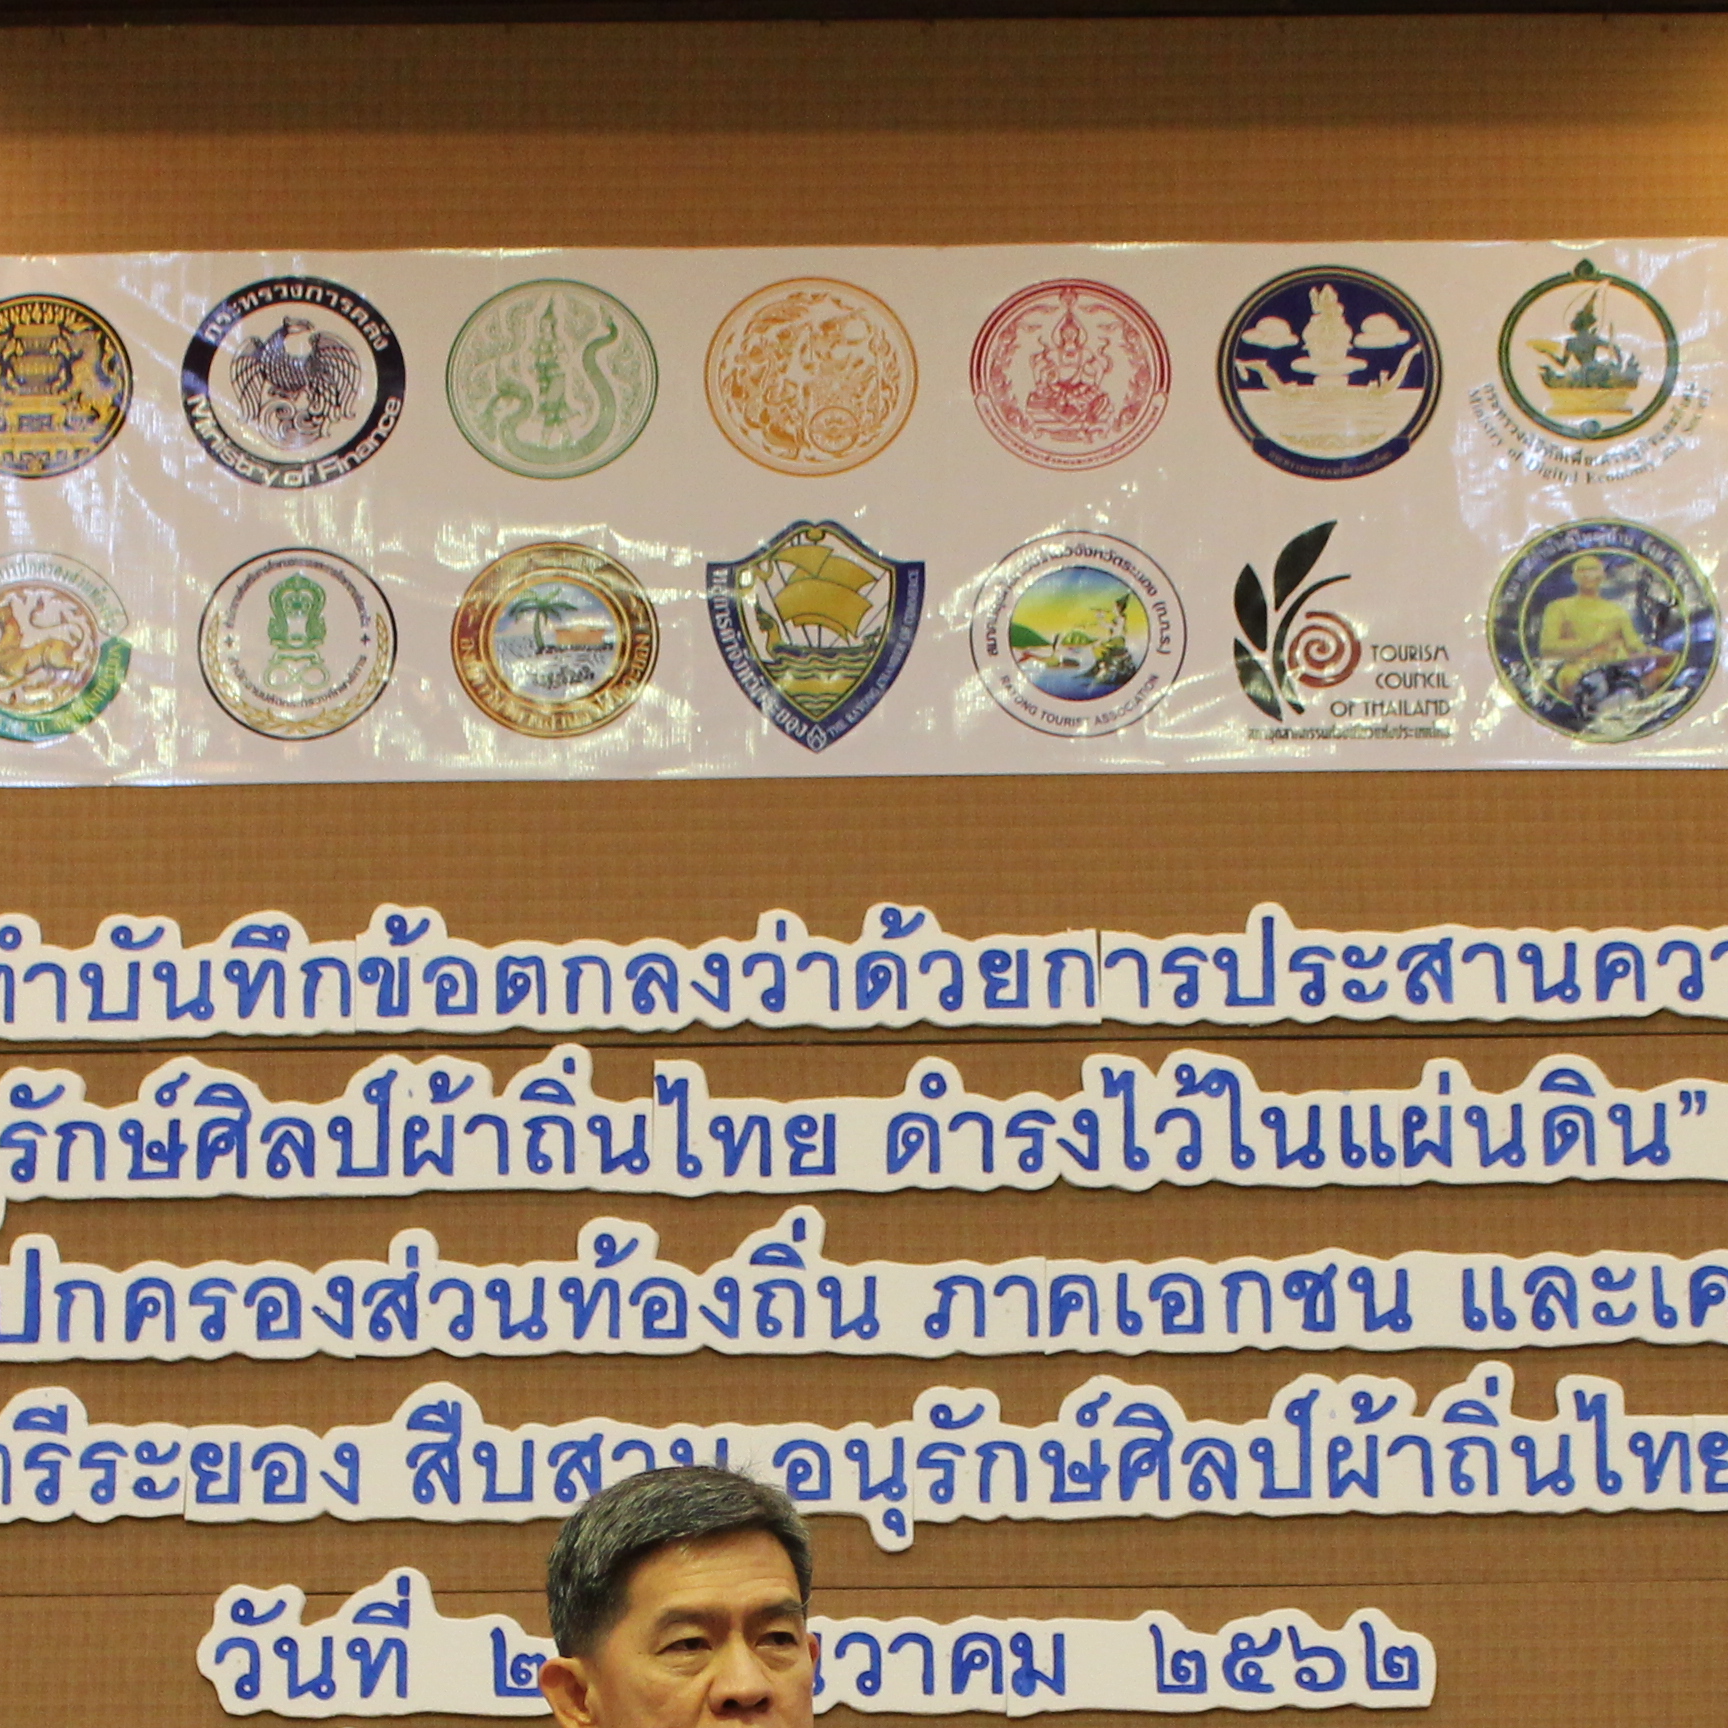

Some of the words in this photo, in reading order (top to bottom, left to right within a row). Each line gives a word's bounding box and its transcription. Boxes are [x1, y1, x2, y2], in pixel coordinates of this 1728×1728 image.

[204, 282, 389, 351] กระทรวงการคลัง
[187, 393, 278, 487] Ministry
[283, 463, 317, 486] of
[316, 396, 402, 481] Finance
[1371, 644, 1450, 662] TOURISM
[1375, 671, 1450, 690] COUNCIL
[1094, 674, 1160, 726] ASSOCIATION
[1330, 701, 1354, 717] OF
[1364, 700, 1451, 717] THAILAND
[887, 1063, 1707, 1174] ดำรงไว้ในแผ่นดิน”
[925, 1263, 1413, 1339] ภาคเอกชน
[215, 1575, 410, 1700] วันที่
[1150, 1621, 1421, 1694] ๒๕๖๒
